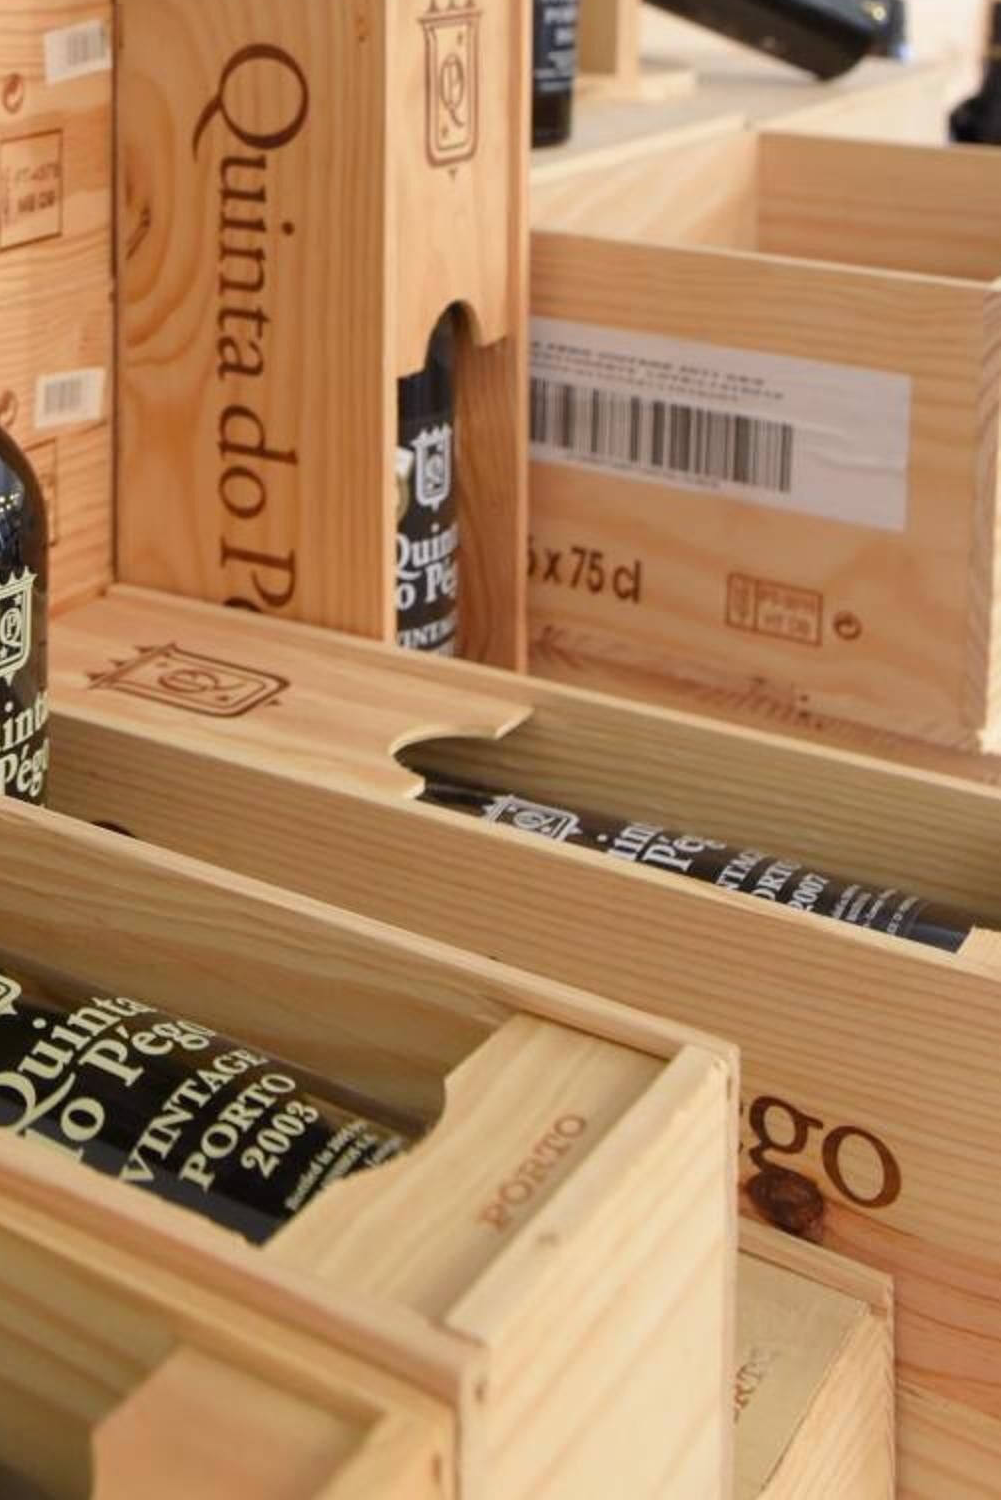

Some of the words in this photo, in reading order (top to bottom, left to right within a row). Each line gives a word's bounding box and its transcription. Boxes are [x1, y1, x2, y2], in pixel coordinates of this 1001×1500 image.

[192, 43, 310, 381] Quinta
[217, 404, 299, 520] do
[119, 1049, 270, 1182] VINTAGE
[179, 1073, 296, 1193] PORTO
[240, 1100, 319, 1179] 2003
[473, 1114, 588, 1233] PORTO
[738, 1094, 902, 1212] go
